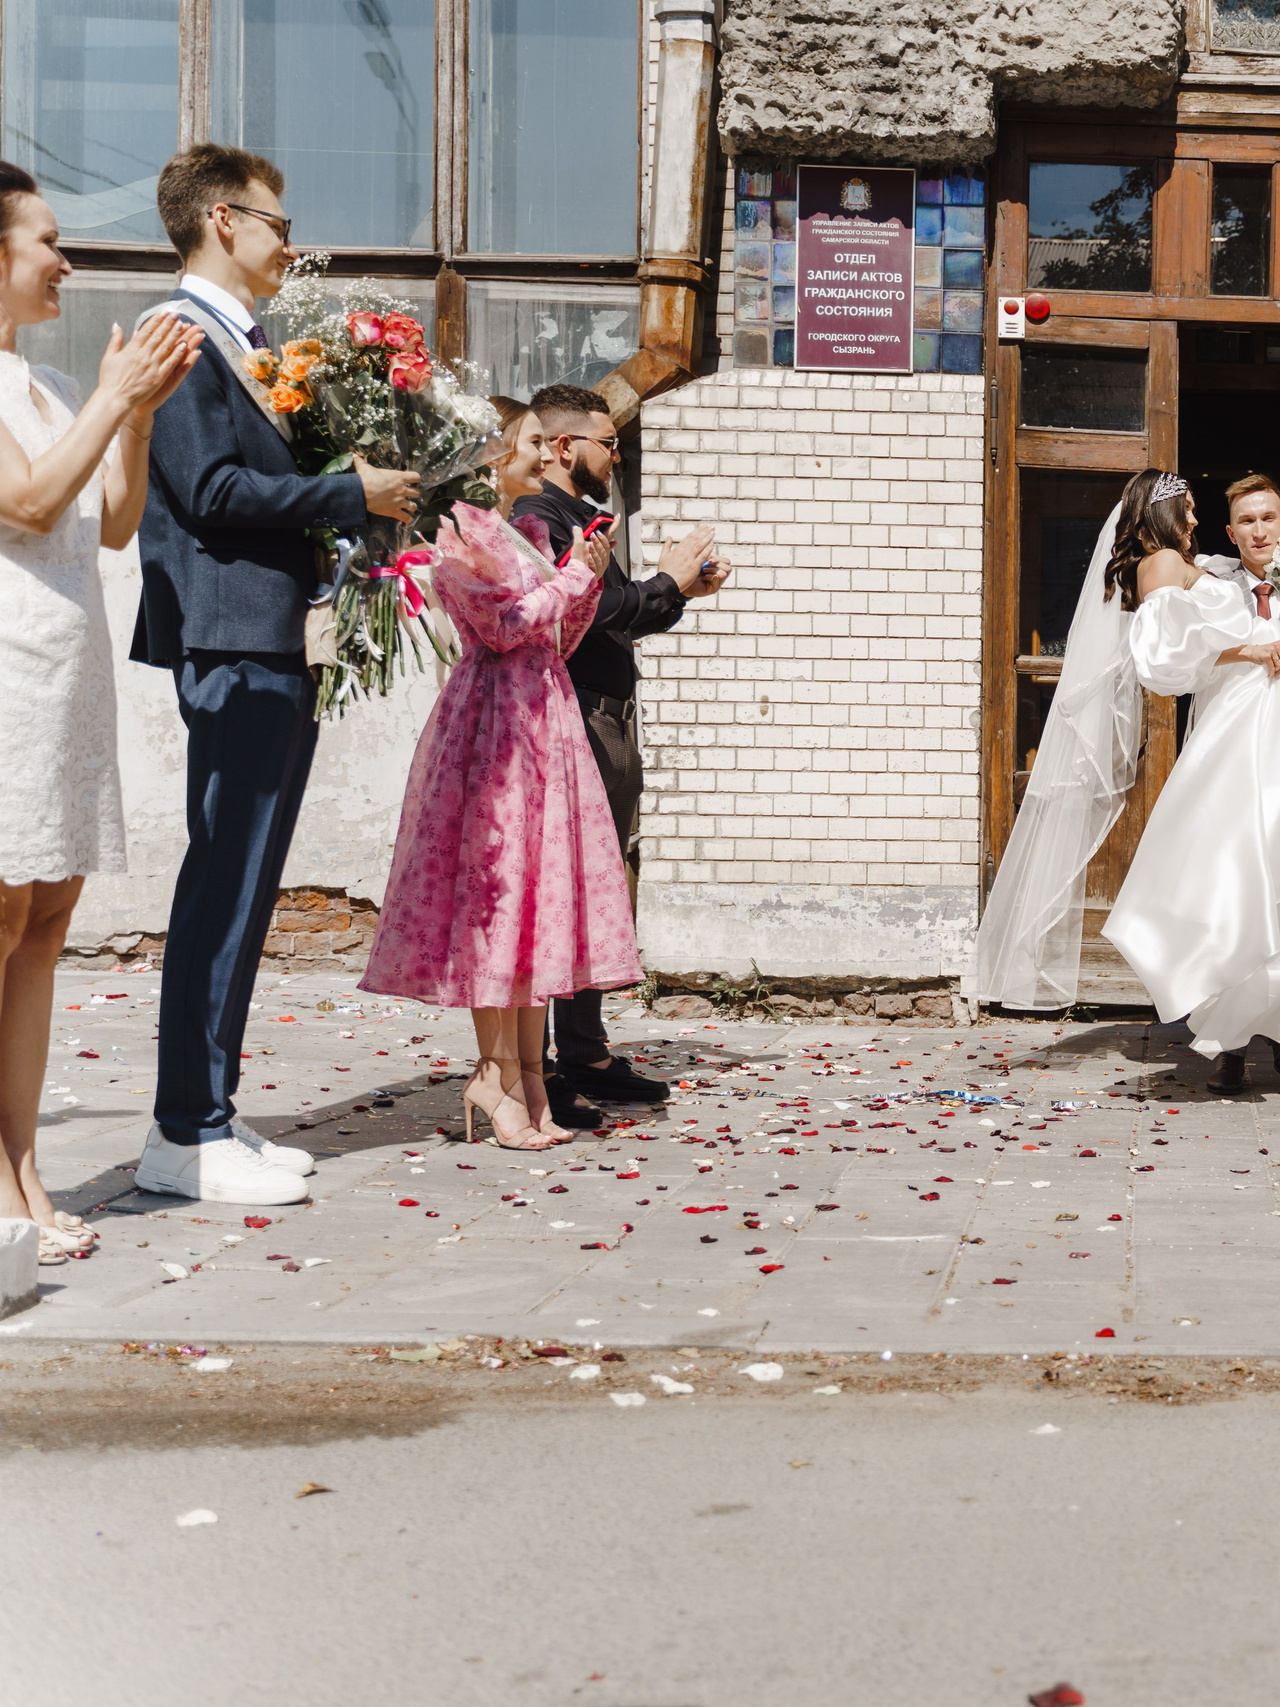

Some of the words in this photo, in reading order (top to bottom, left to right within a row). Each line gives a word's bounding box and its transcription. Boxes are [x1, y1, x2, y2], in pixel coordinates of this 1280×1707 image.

[834, 253, 876, 264] ОТДЕЛ
[807, 270, 858, 281] ЗАПИСИ
[861, 272, 902, 283] АКТОВ
[804, 288, 905, 300] ГРАЖДАНСКОГО
[816, 306, 892, 317] СОСТОЯНИЯ
[808, 333, 866, 342] ГОРОДСКОГО
[868, 334, 900, 343] ОКРУГА
[832, 346, 876, 354] СЫЗРАНЬ
